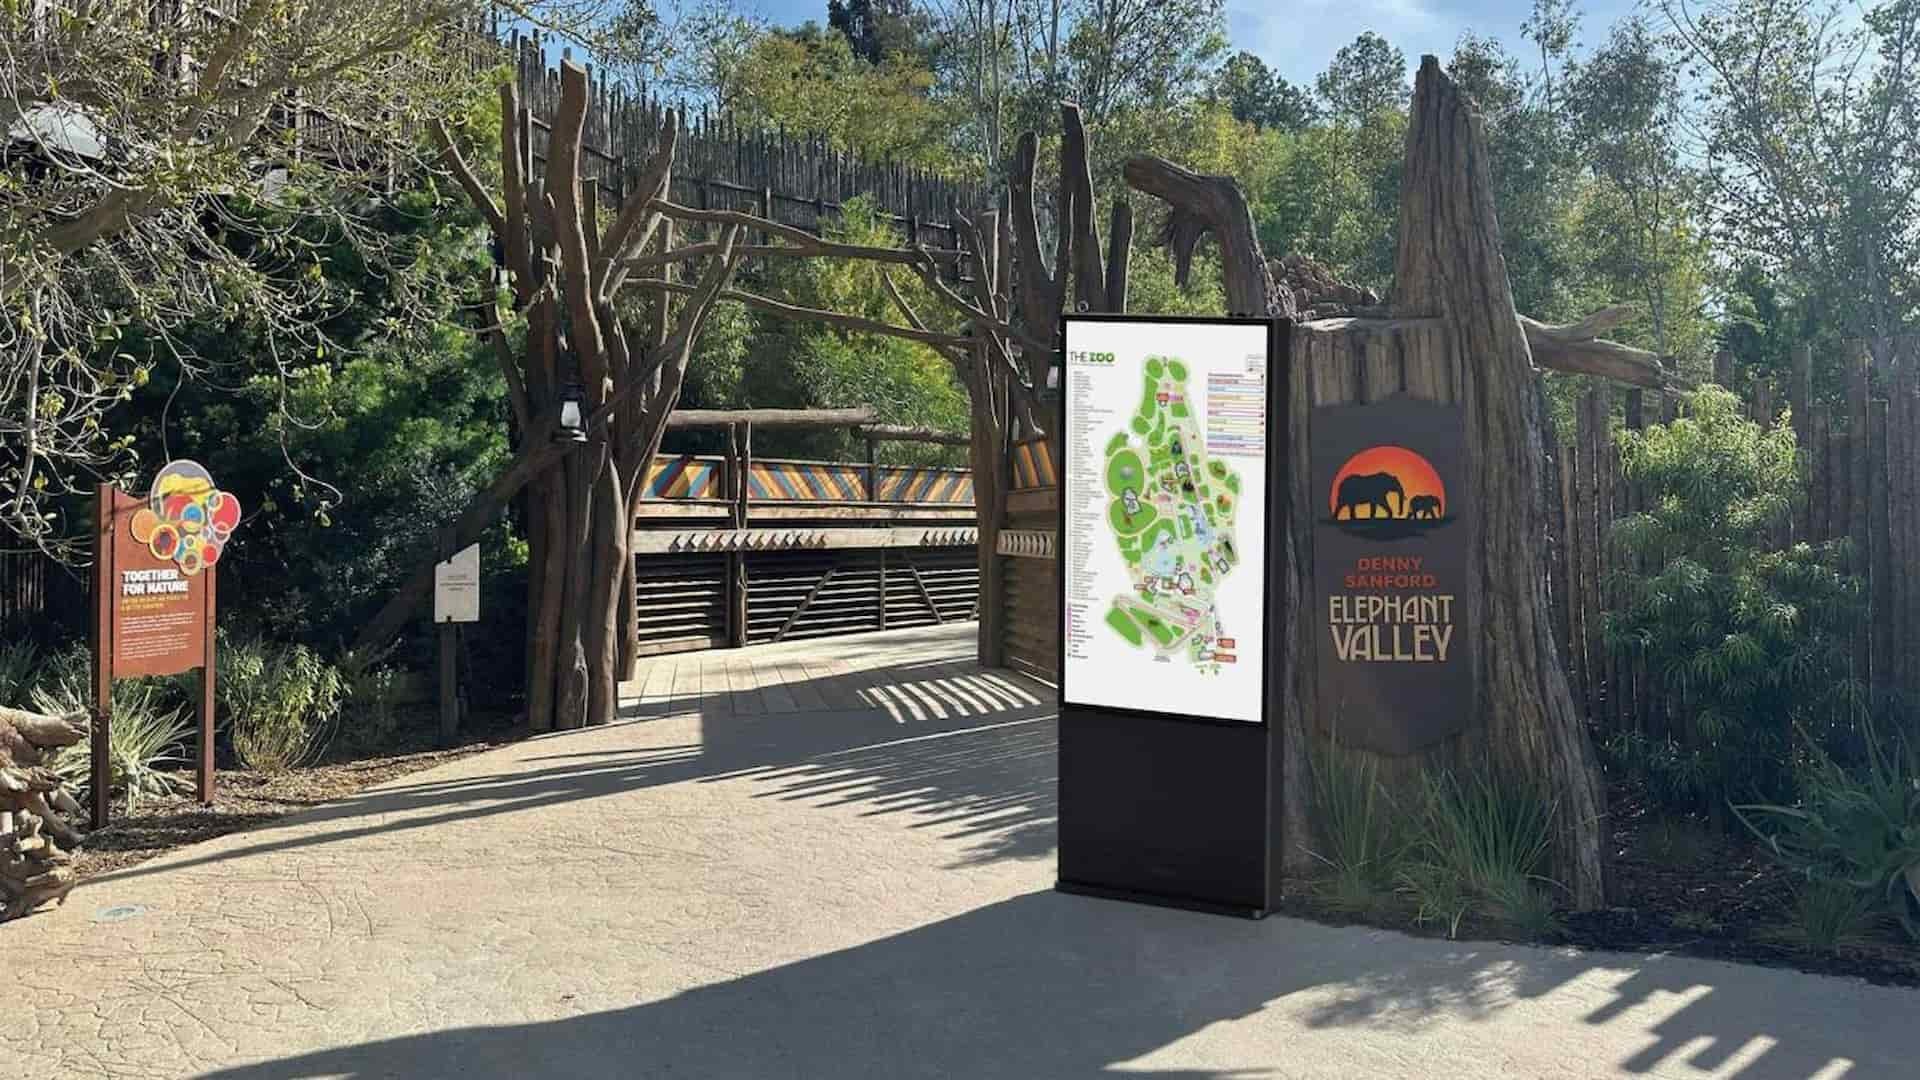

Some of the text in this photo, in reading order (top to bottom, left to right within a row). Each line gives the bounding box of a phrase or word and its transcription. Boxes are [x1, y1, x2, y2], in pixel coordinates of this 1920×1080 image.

[1070, 351, 1114, 362] THE ZOO
[1358, 556, 1422, 571] DENNY
[122, 569, 178, 582] TOGETHER
[1344, 575, 1437, 588] SANFORD
[123, 580, 188, 595] FOR NATURE
[1329, 595, 1454, 623] ELEPHANT
[1331, 624, 1453, 661] VALLEY
